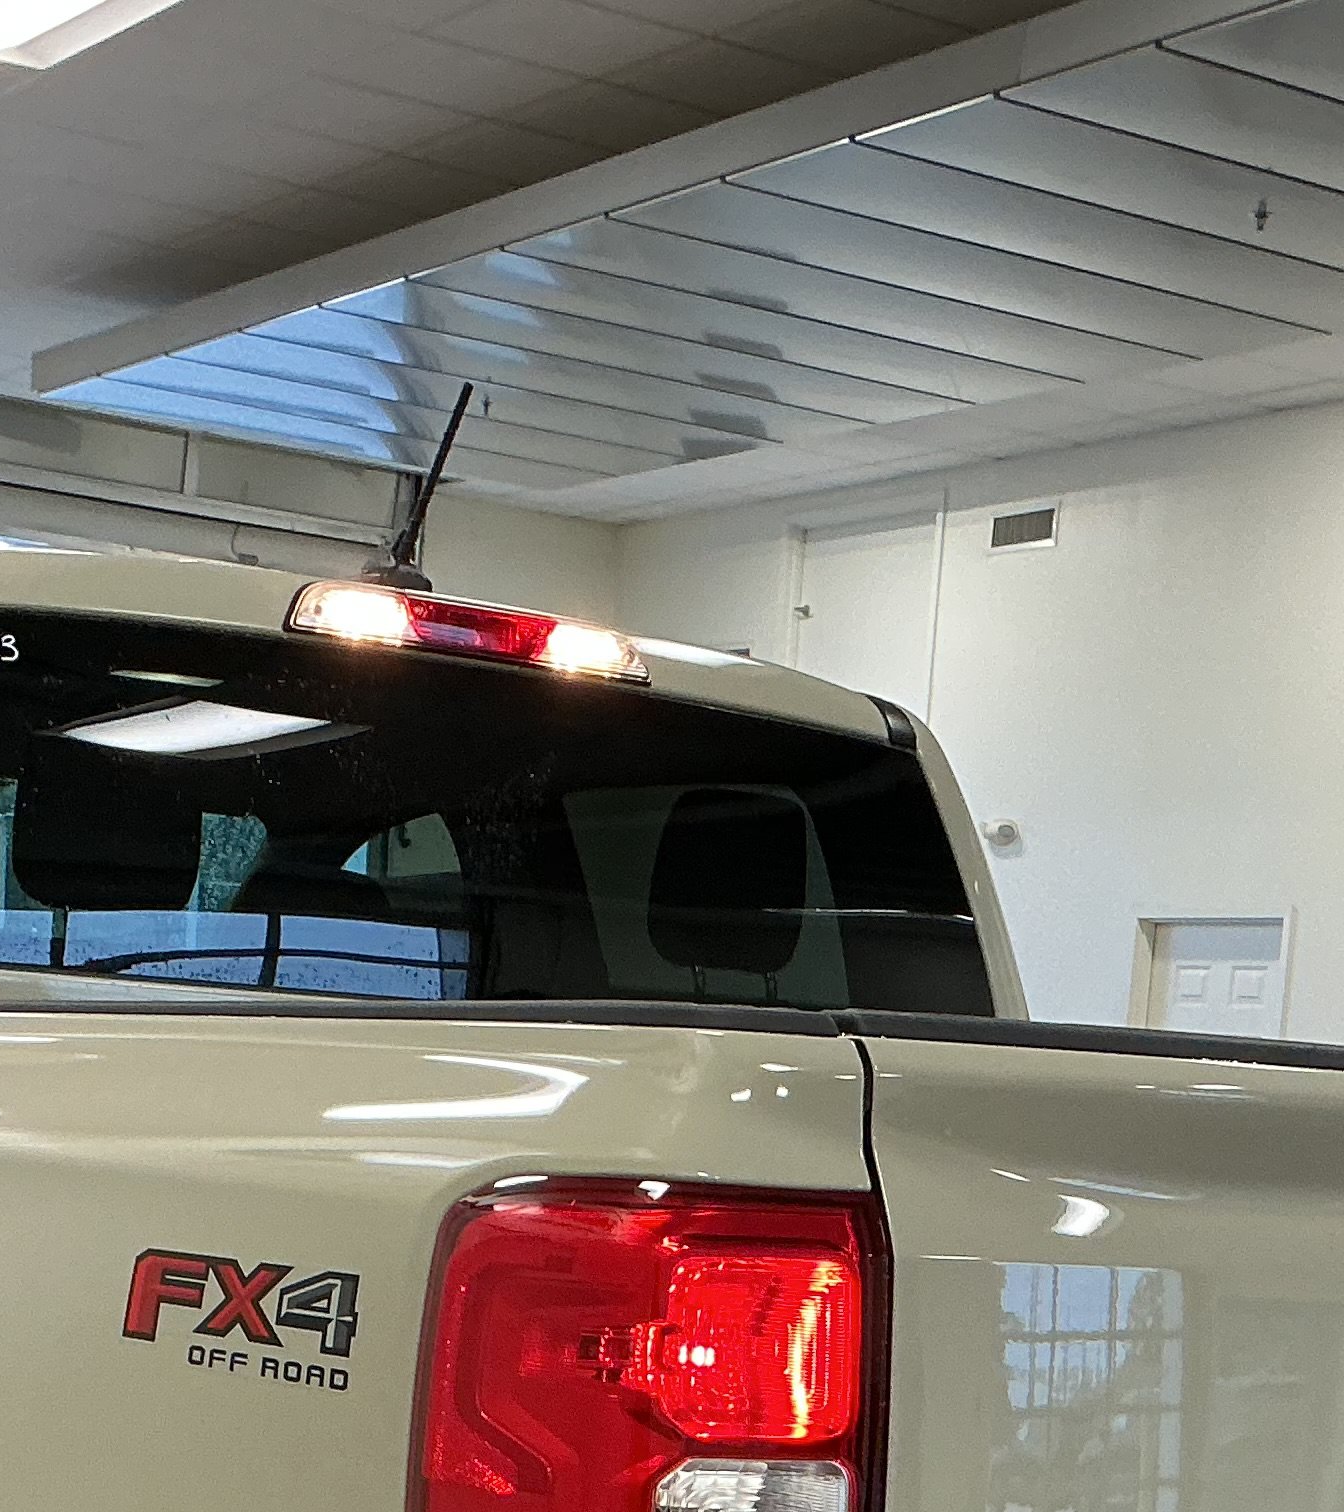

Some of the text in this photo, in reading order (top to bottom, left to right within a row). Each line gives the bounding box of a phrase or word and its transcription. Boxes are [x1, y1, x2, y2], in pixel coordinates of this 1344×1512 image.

[122, 1248, 360, 1358] FX4
[187, 1345, 349, 1391] OFF ROAD
